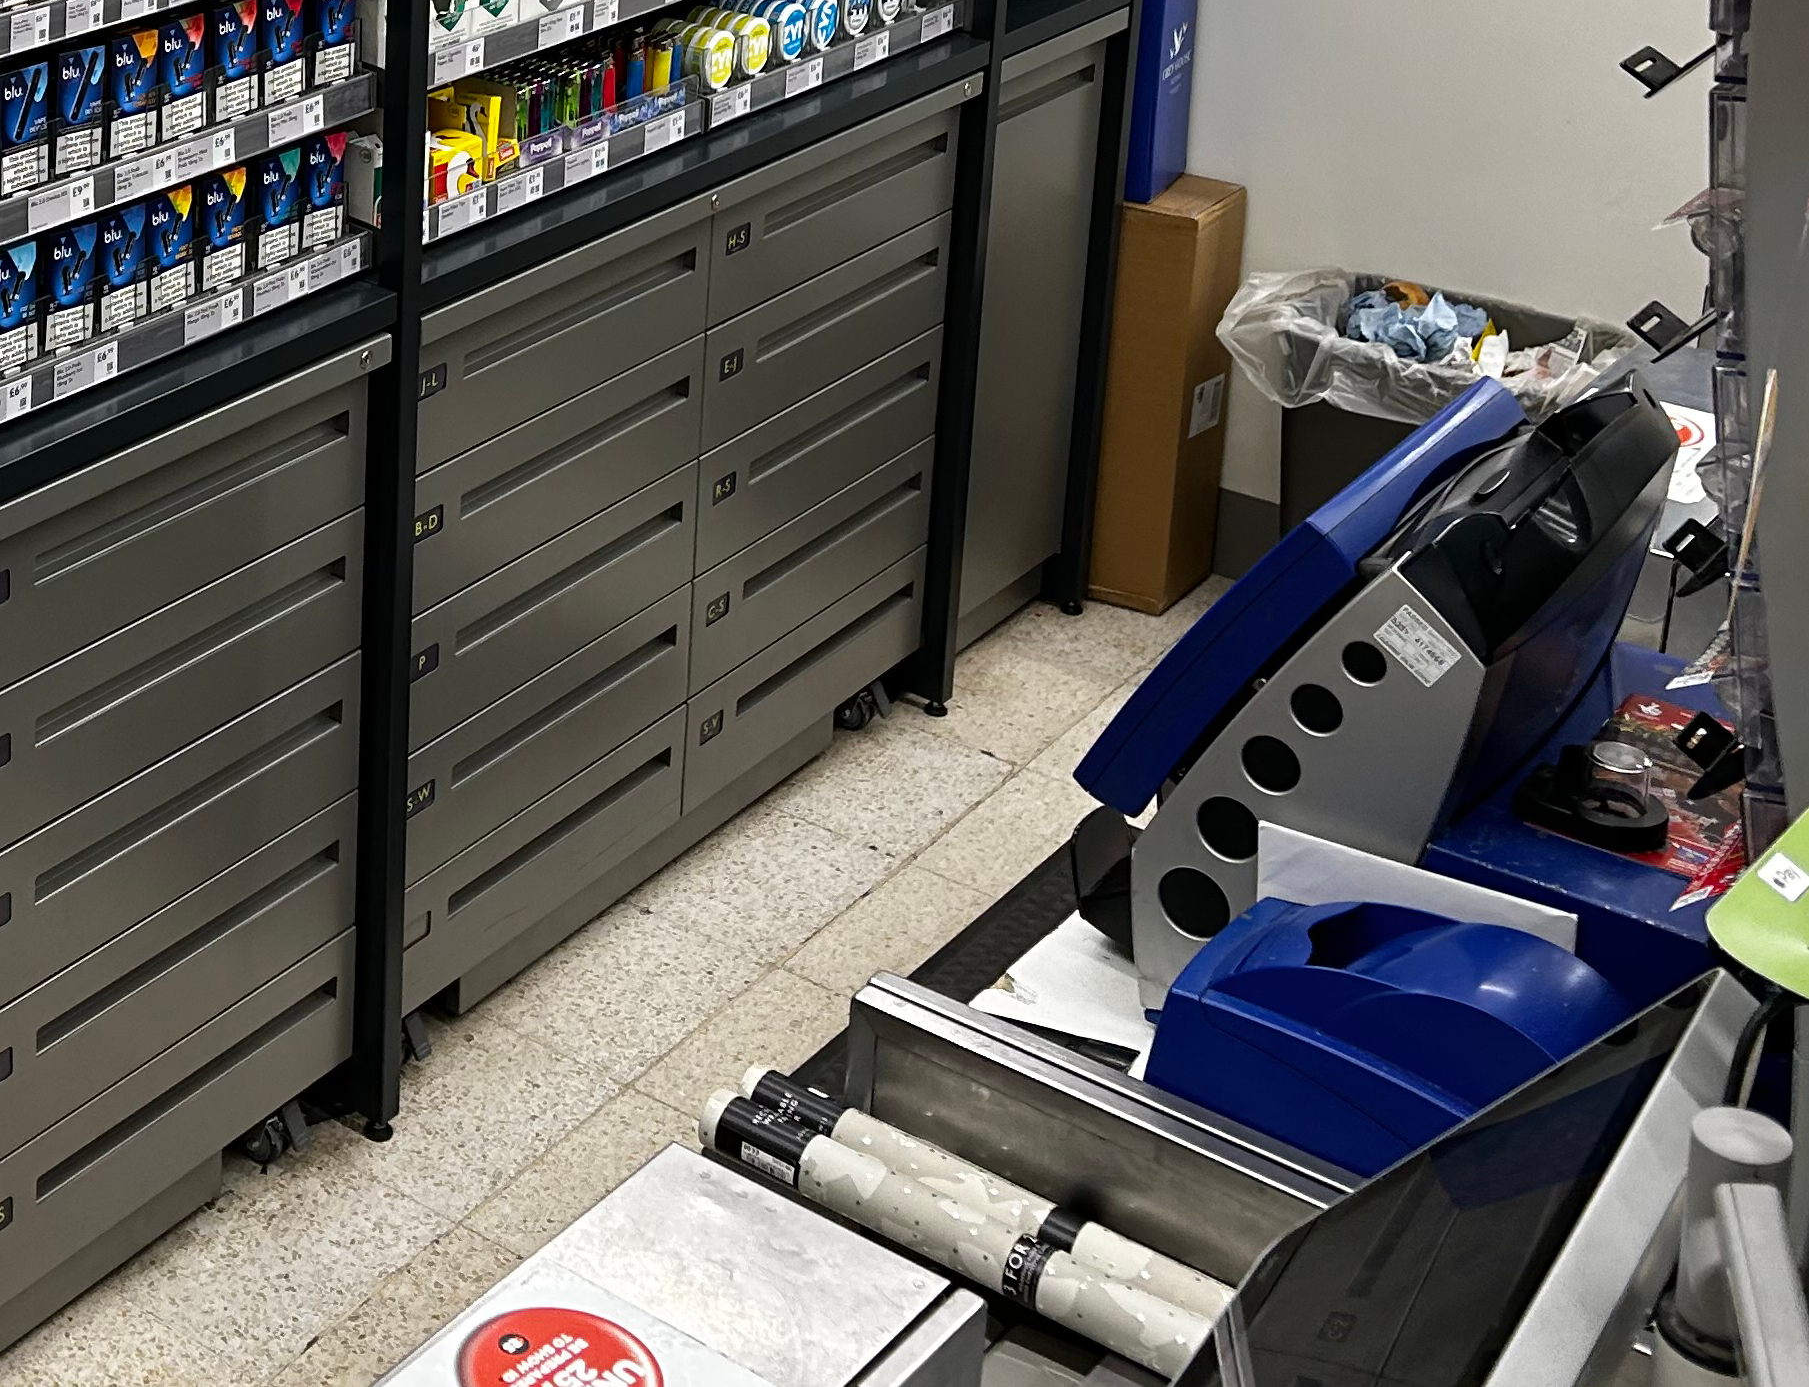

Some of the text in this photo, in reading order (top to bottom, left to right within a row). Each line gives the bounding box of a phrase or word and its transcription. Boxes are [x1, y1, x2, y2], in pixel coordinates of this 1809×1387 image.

[727, 232, 748, 252] H-S
[414, 513, 439, 536] B-D
[417, 654, 427, 673] P
[1004, 1243, 1032, 1281] FOR
